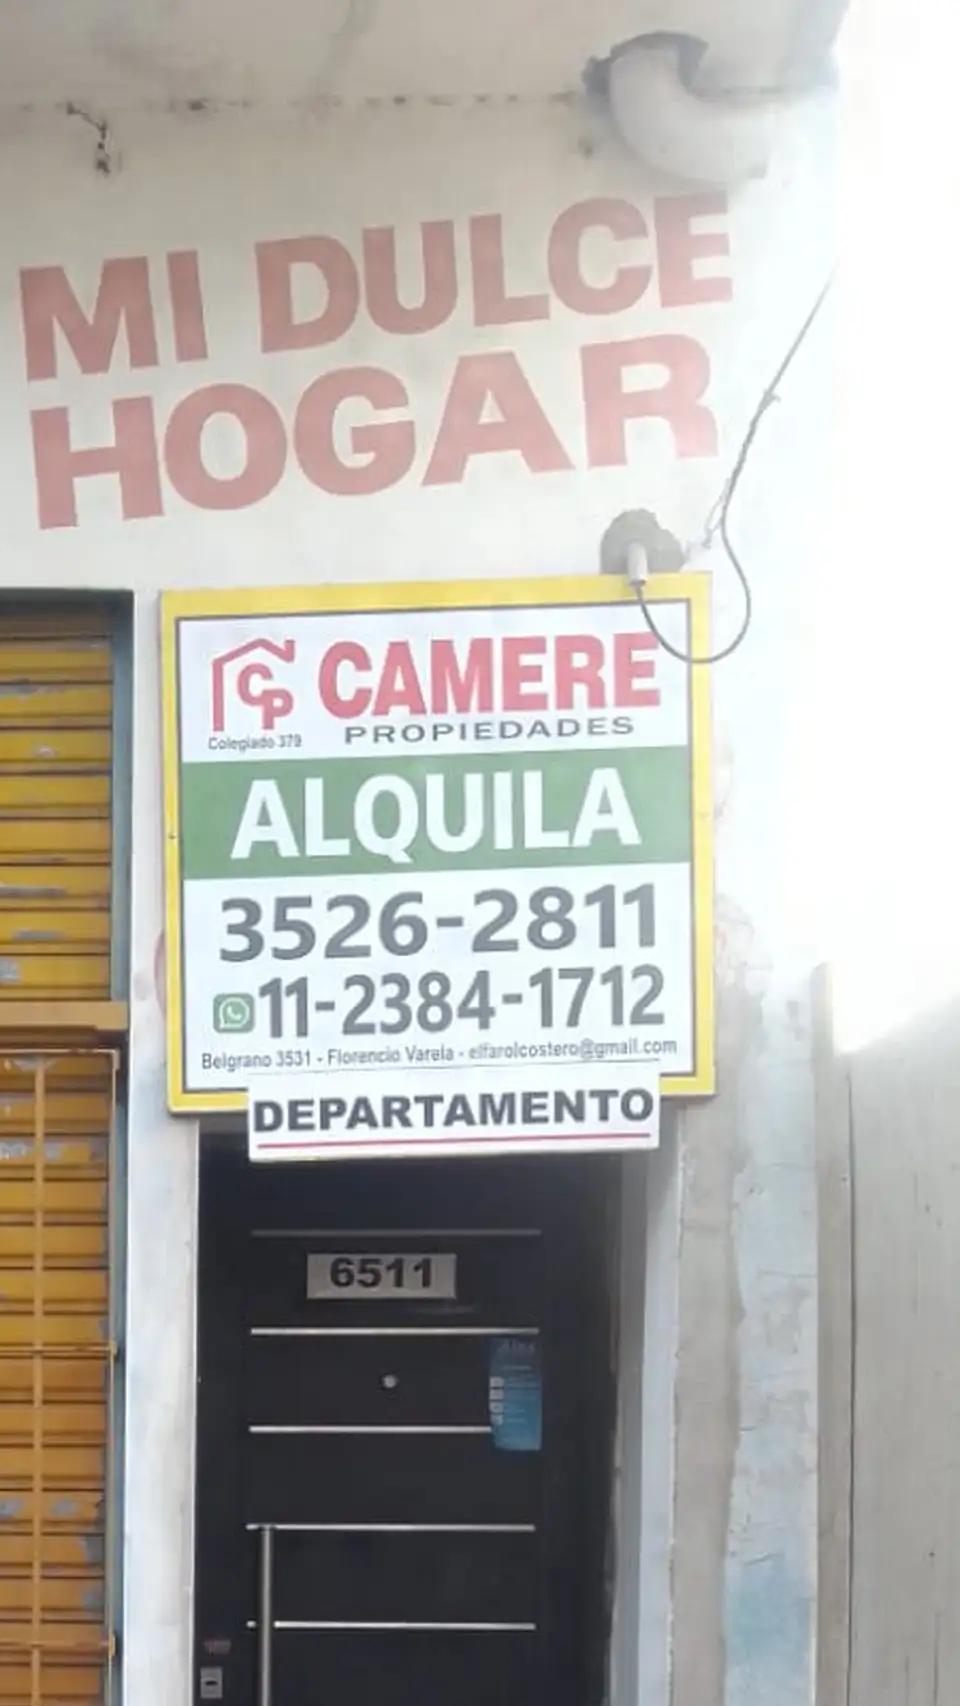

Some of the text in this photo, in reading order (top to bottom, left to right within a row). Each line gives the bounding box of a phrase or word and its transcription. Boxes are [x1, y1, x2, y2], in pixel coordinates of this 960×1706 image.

[19, 190, 734, 382] MI DULCE
[30, 333, 719, 530] HOGAR
[317, 632, 662, 719] CAMERE
[344, 716, 634, 744] PROPIEDADES
[230, 767, 642, 863] ALQUILA
[219, 882, 656, 963] 3526-2811
[258, 963, 666, 1038] 11-2384-1712
[201, 1052, 272, 1072] Belgrano
[276, 1050, 311, 1067] 3531
[327, 1046, 401, 1065] Florencio
[405, 1045, 454, 1061] Varela
[253, 1088, 654, 1132] DEPARTAMENTO
[329, 1256, 432, 1289] 6511
